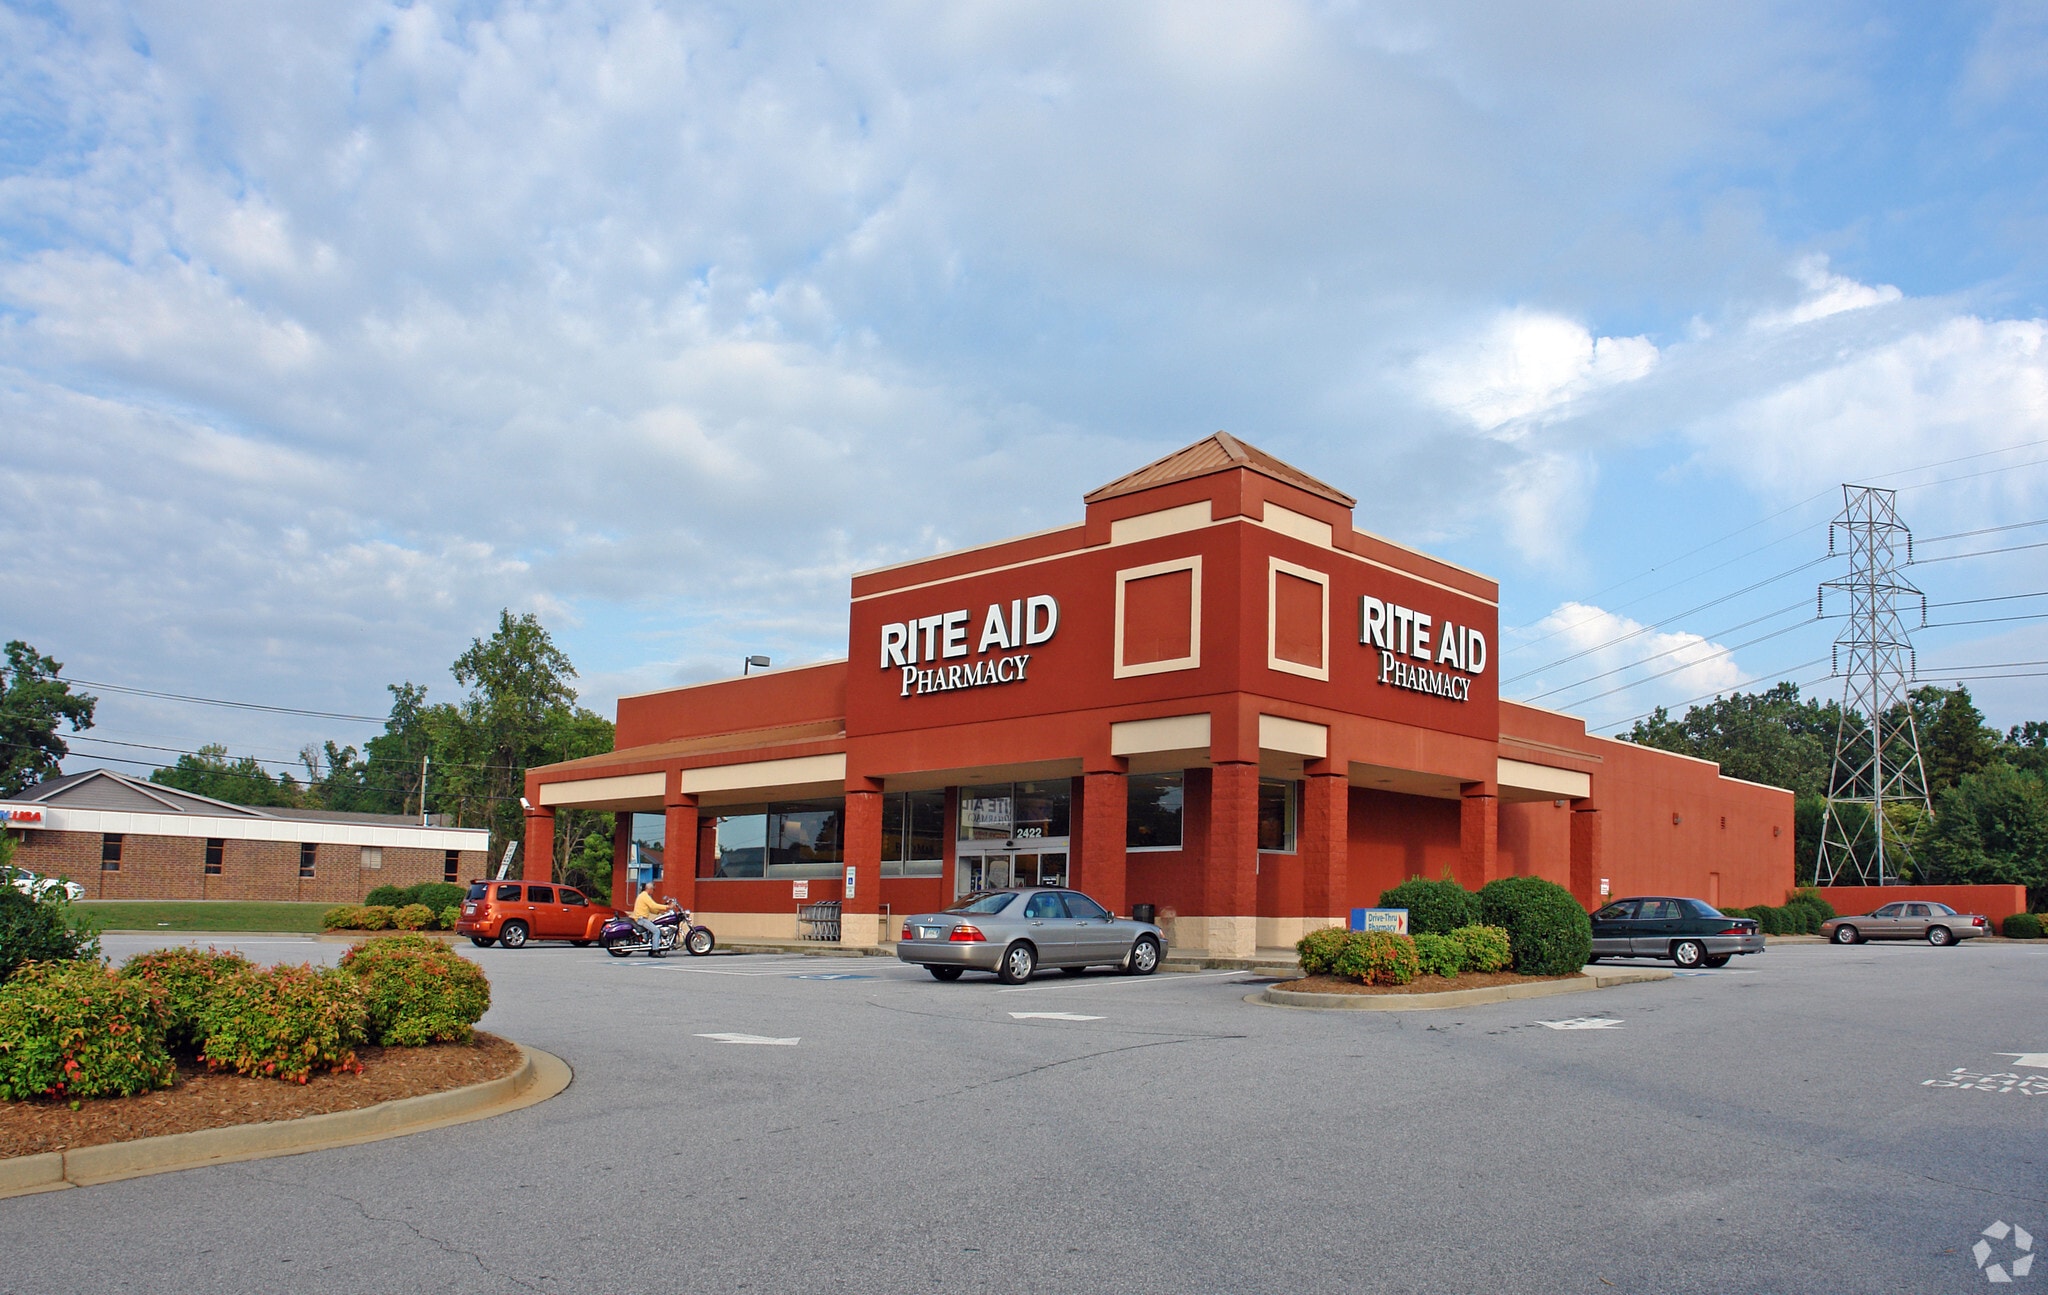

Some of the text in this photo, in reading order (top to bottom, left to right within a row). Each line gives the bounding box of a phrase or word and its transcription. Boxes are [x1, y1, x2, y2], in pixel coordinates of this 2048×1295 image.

[881, 594, 1059, 669] RITE AID
[1362, 595, 1487, 674] RITE AID
[1017, 828, 1042, 838] 2422
[1368, 913, 1398, 922] Drive-Thru
